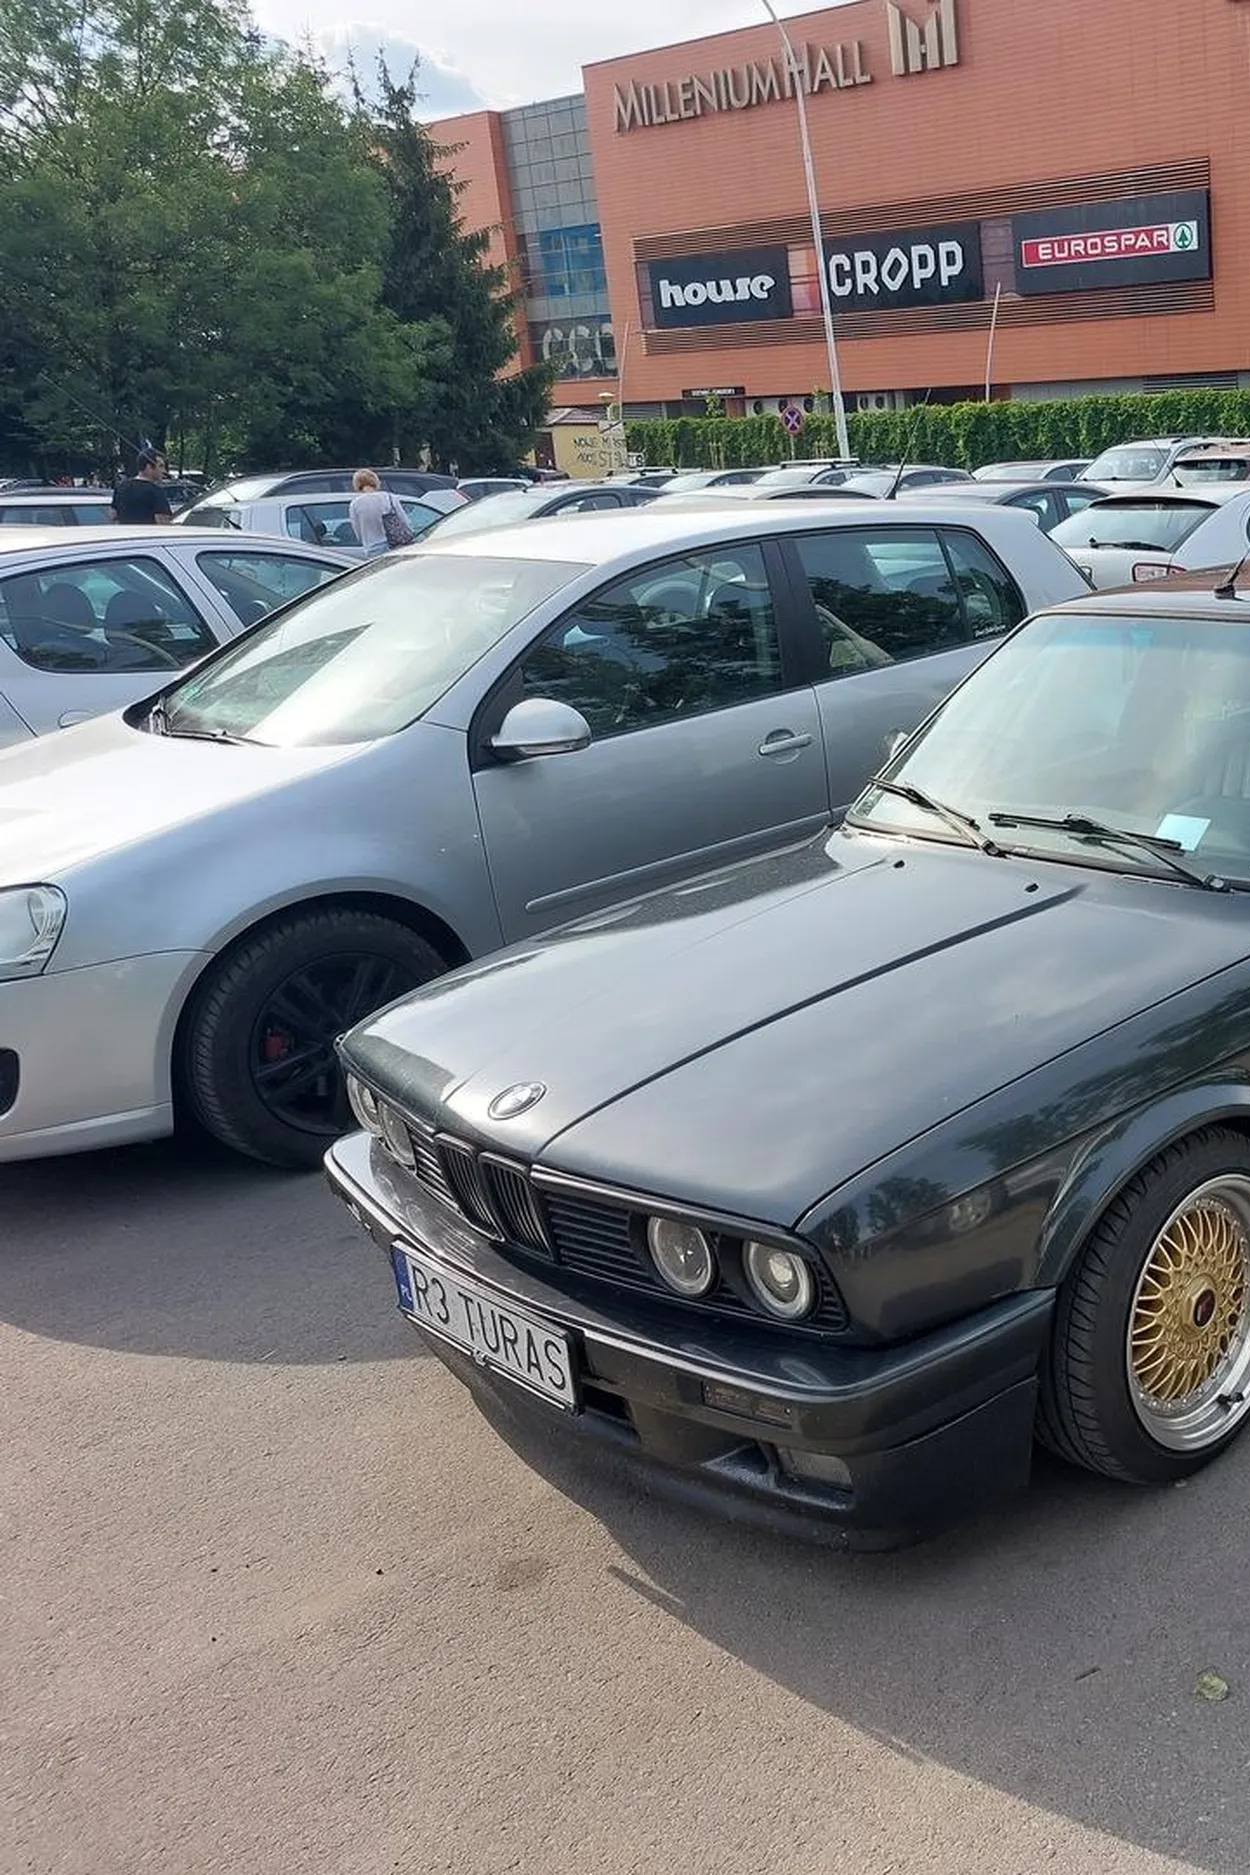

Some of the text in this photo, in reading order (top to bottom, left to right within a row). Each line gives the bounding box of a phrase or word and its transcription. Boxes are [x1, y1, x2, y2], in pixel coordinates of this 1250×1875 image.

[1037, 229, 1169, 260] EUROSPAR
[658, 274, 776, 309] house
[828, 240, 965, 297] CROPP
[412, 1265, 566, 1391] R3 TURAS
